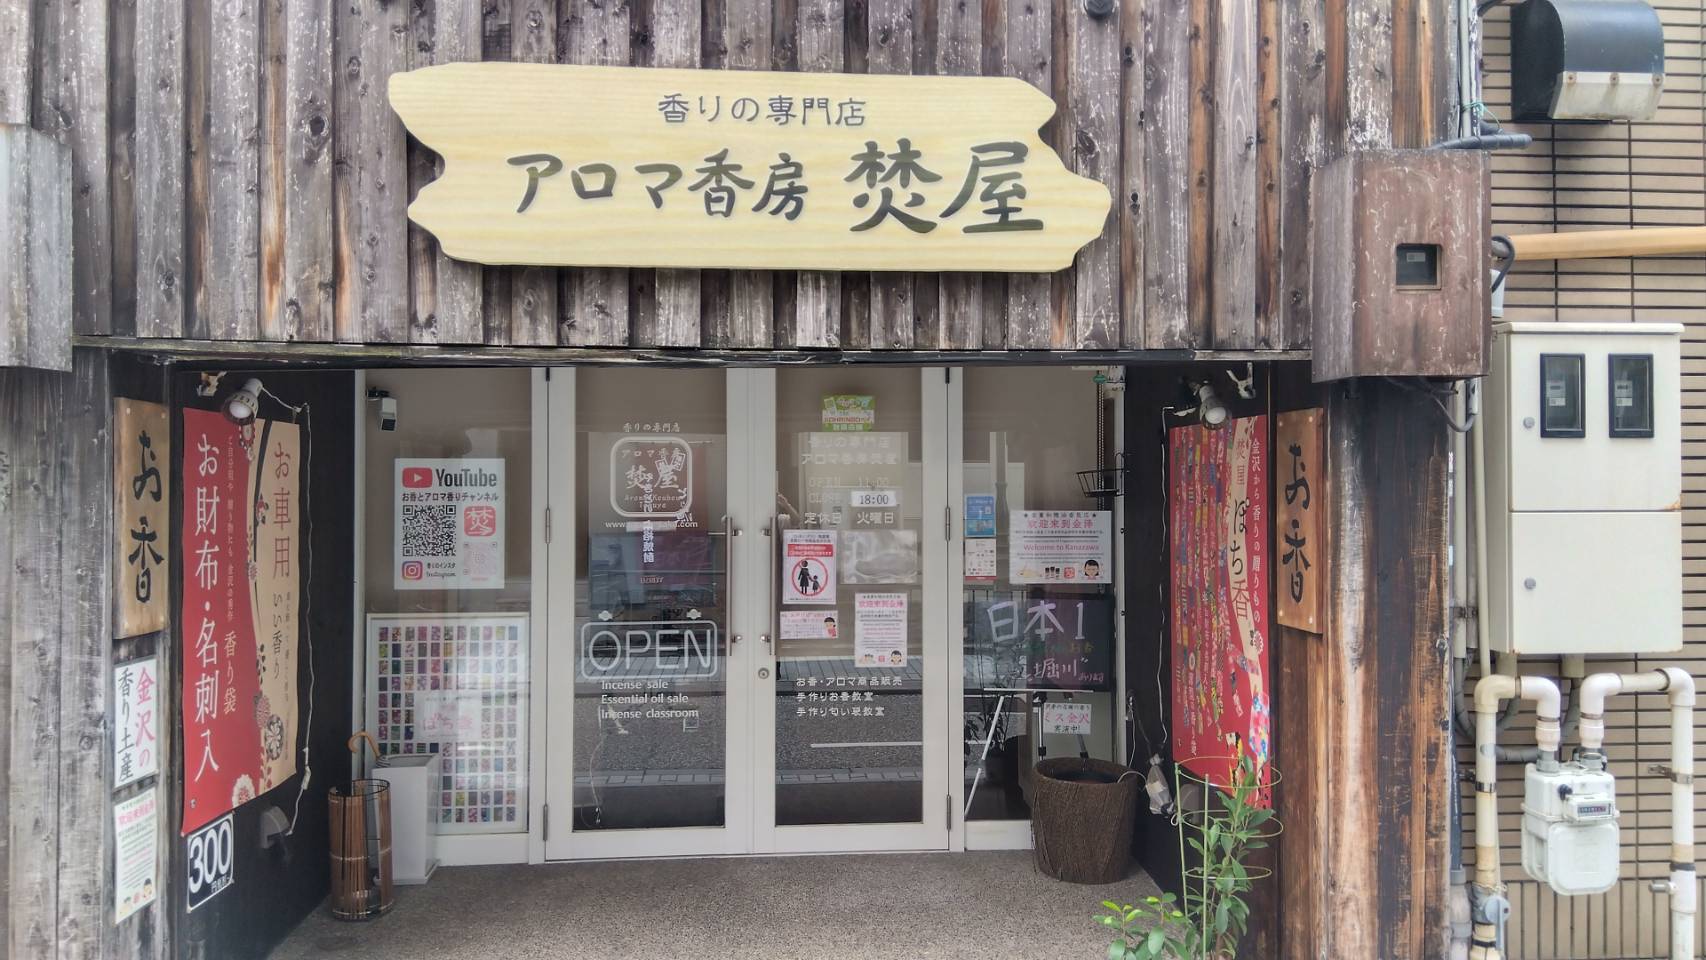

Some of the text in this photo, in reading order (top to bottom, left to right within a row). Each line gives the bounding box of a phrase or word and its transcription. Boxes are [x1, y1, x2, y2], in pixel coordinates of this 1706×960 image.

[658, 94, 867, 127] 香りの専門店
[507, 138, 1044, 235] アロマ香房 焚屋
[623, 422, 680, 433] 香りの専門店
[436, 468, 497, 487] YouTube
[402, 492, 499, 502] お香とアロマ香りチャンネル
[860, 494, 889, 505] 18:00
[128, 430, 164, 603] お香
[272, 442, 291, 579] お車用
[804, 511, 894, 524] 定休日 火曜日
[1282, 443, 1311, 603] お香
[195, 433, 220, 783] お財布・名刺入
[589, 629, 711, 671] OPEN
[601, 679, 669, 690] Incense sale
[796, 676, 903, 687] お香・アロマ商品販売
[601, 693, 689, 704] Essential oil sale
[796, 691, 874, 702] 手作りお香教室
[117, 668, 135, 782] 香り土産
[135, 667, 156, 768] 金沢の
[601, 708, 699, 719] Incense classroom
[188, 821, 231, 894] 300
